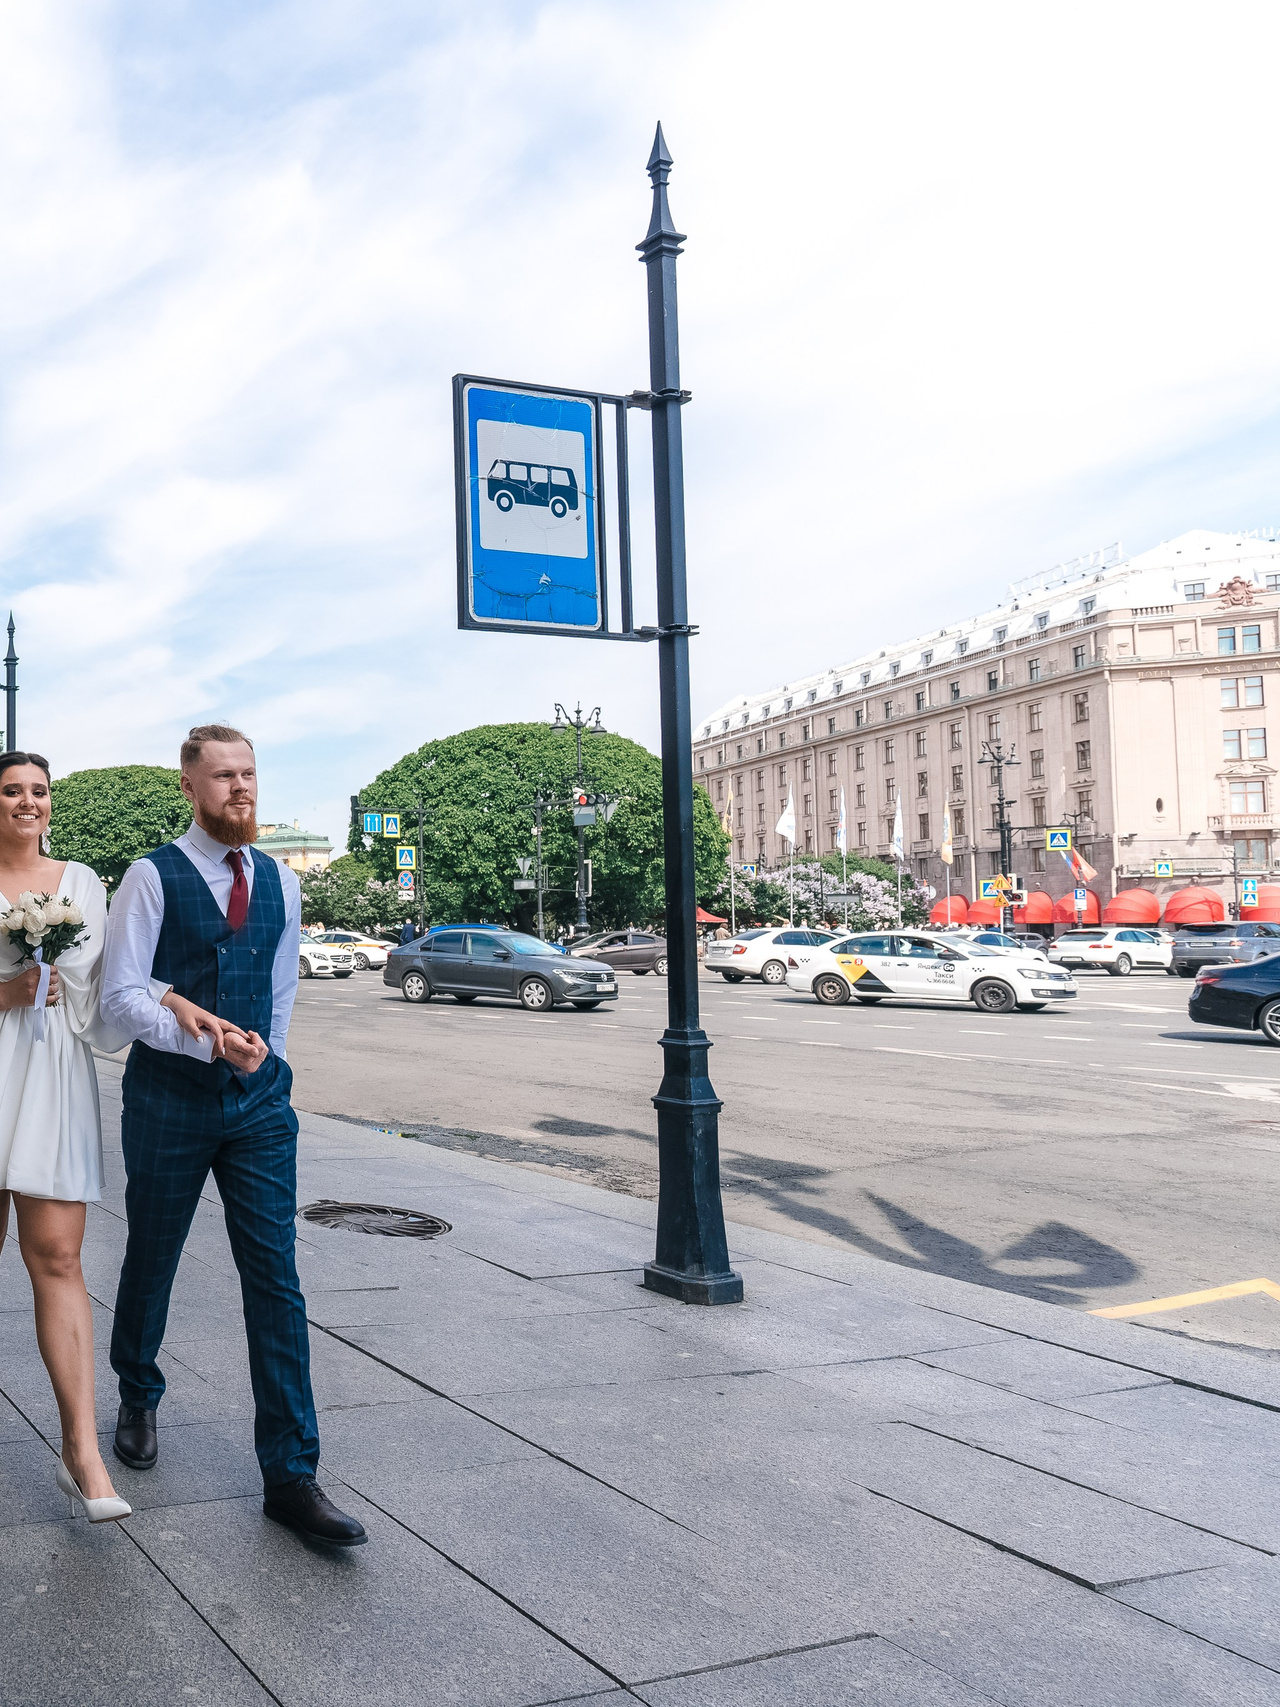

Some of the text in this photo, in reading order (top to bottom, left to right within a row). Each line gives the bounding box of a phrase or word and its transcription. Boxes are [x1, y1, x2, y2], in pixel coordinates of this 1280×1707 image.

[1203, 661, 1280, 674] ASTORIA
[1076, 890, 1085, 899] P
[917, 962, 955, 971] Яндекс Go
[934, 971, 954, 979] Такси
